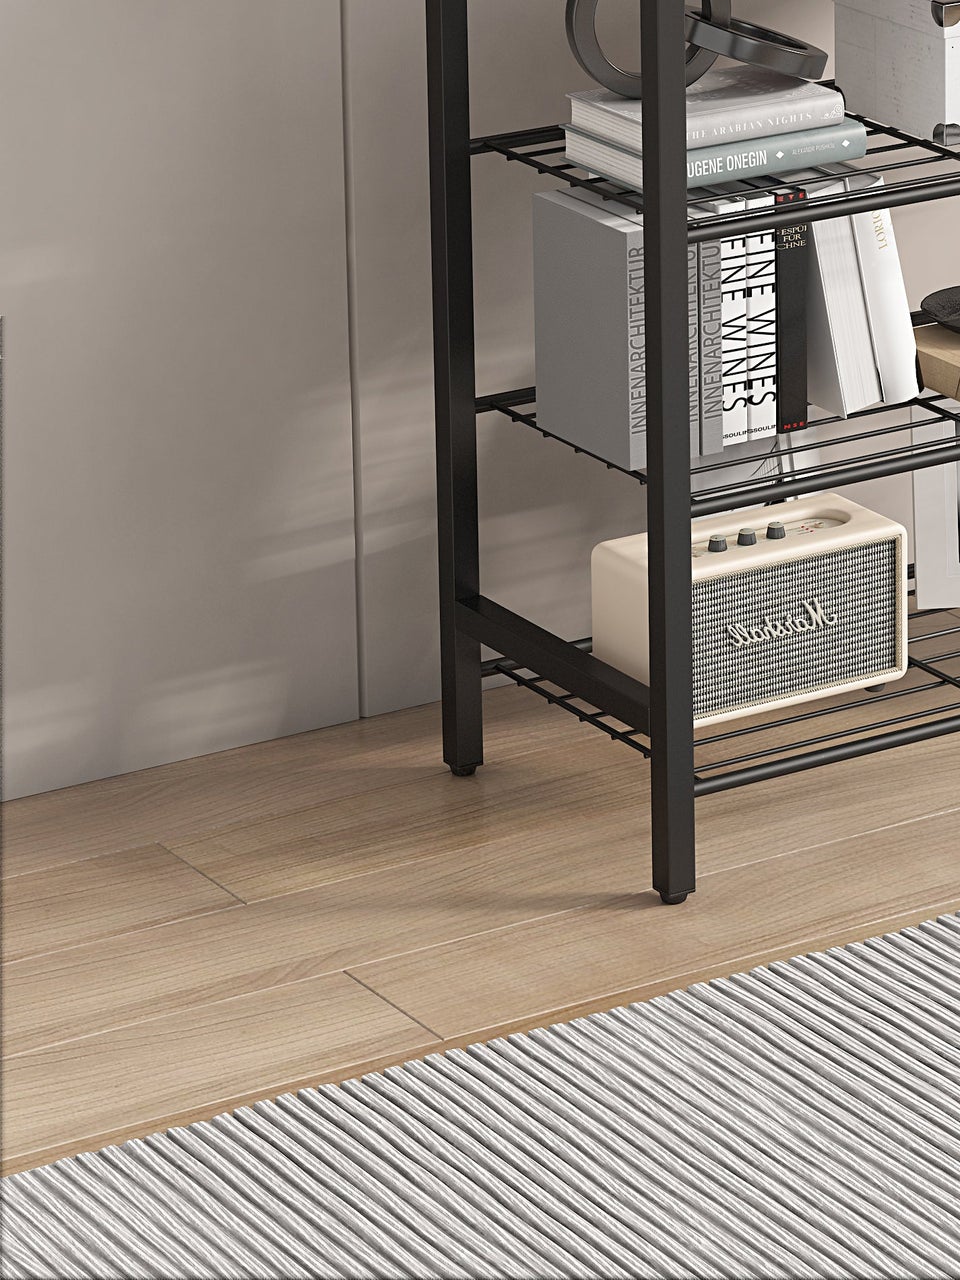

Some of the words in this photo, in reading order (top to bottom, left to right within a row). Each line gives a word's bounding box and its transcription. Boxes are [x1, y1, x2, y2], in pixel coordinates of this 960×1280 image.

[712, 119, 763, 137] ARABIAN
[767, 112, 813, 127] NIGHTS
[687, 157, 724, 178] UGENE
[726, 149, 768, 171] ONEGIN
